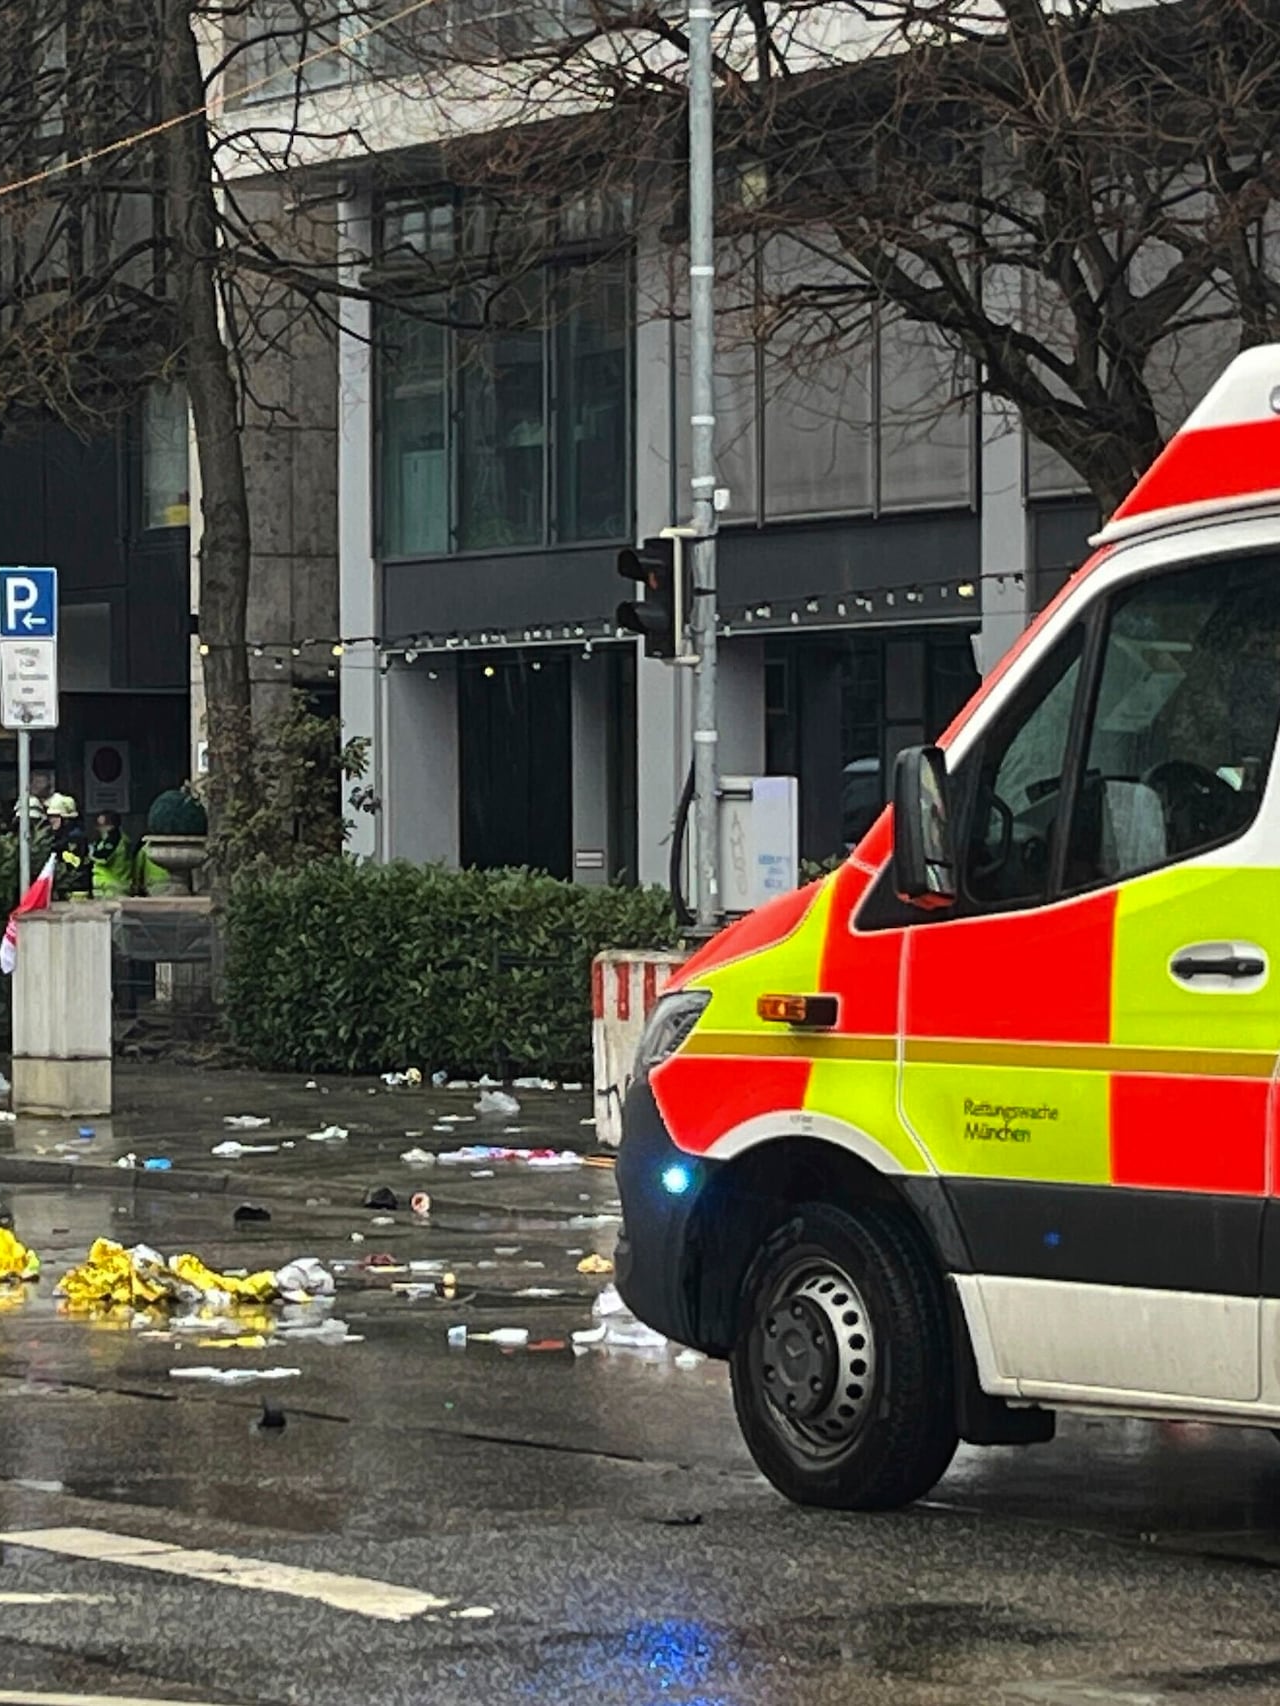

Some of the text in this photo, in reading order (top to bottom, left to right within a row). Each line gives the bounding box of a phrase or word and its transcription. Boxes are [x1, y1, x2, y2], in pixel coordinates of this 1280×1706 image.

[6, 577, 38, 630] P
[963, 1098, 1059, 1122] Rettungswache
[963, 1122, 1032, 1142] München
